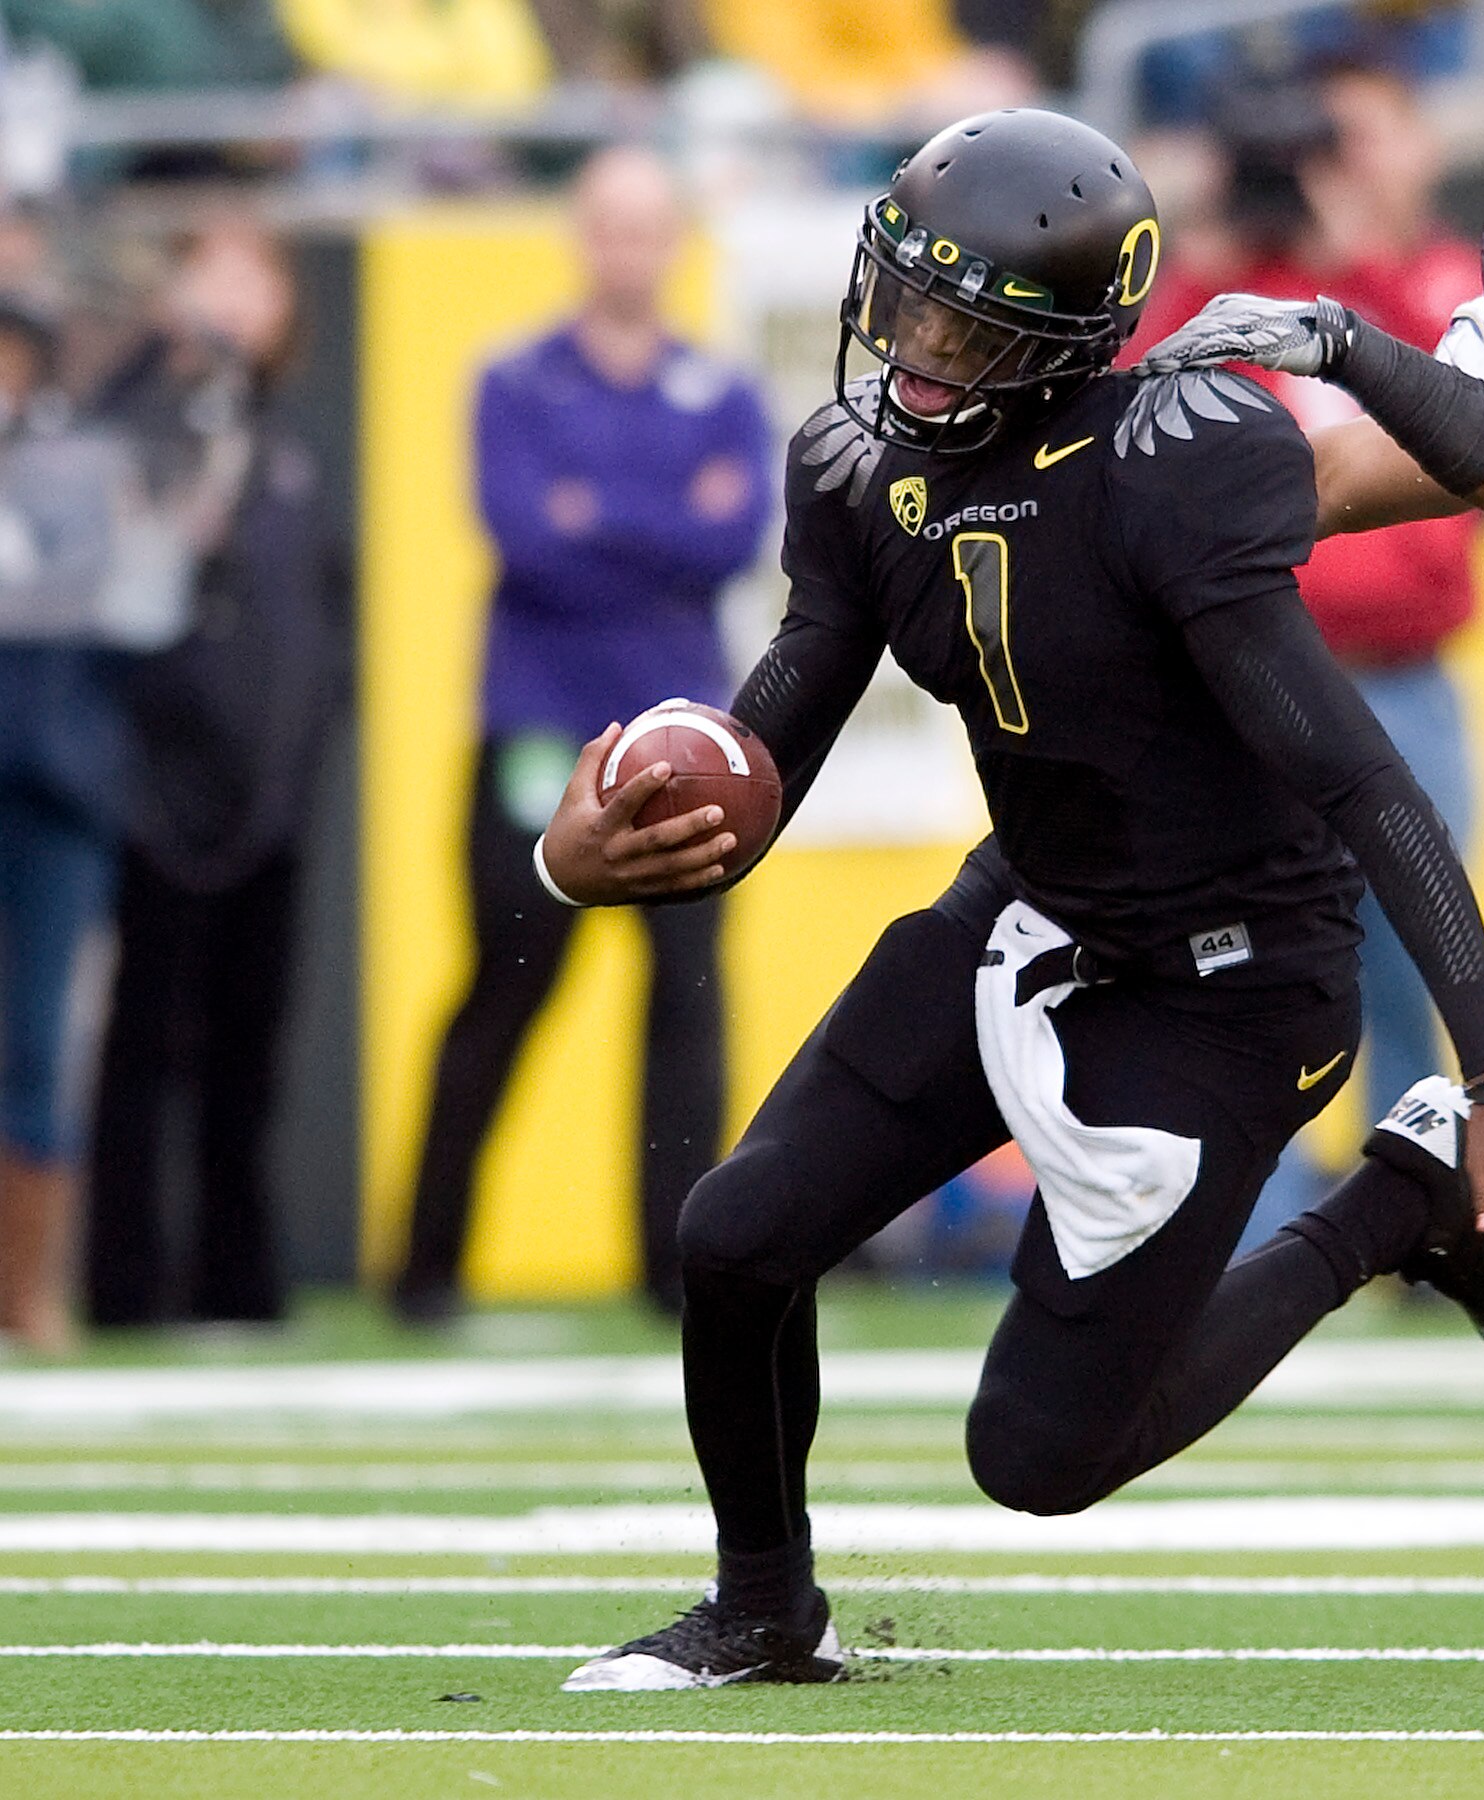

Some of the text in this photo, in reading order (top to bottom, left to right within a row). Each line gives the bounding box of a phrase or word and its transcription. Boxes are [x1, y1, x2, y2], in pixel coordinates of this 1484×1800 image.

[931, 239, 960, 265] O
[1119, 218, 1160, 306] O
[922, 500, 1038, 541] OREGON
[952, 532, 1030, 736] 1
[1201, 932, 1234, 952] 44
